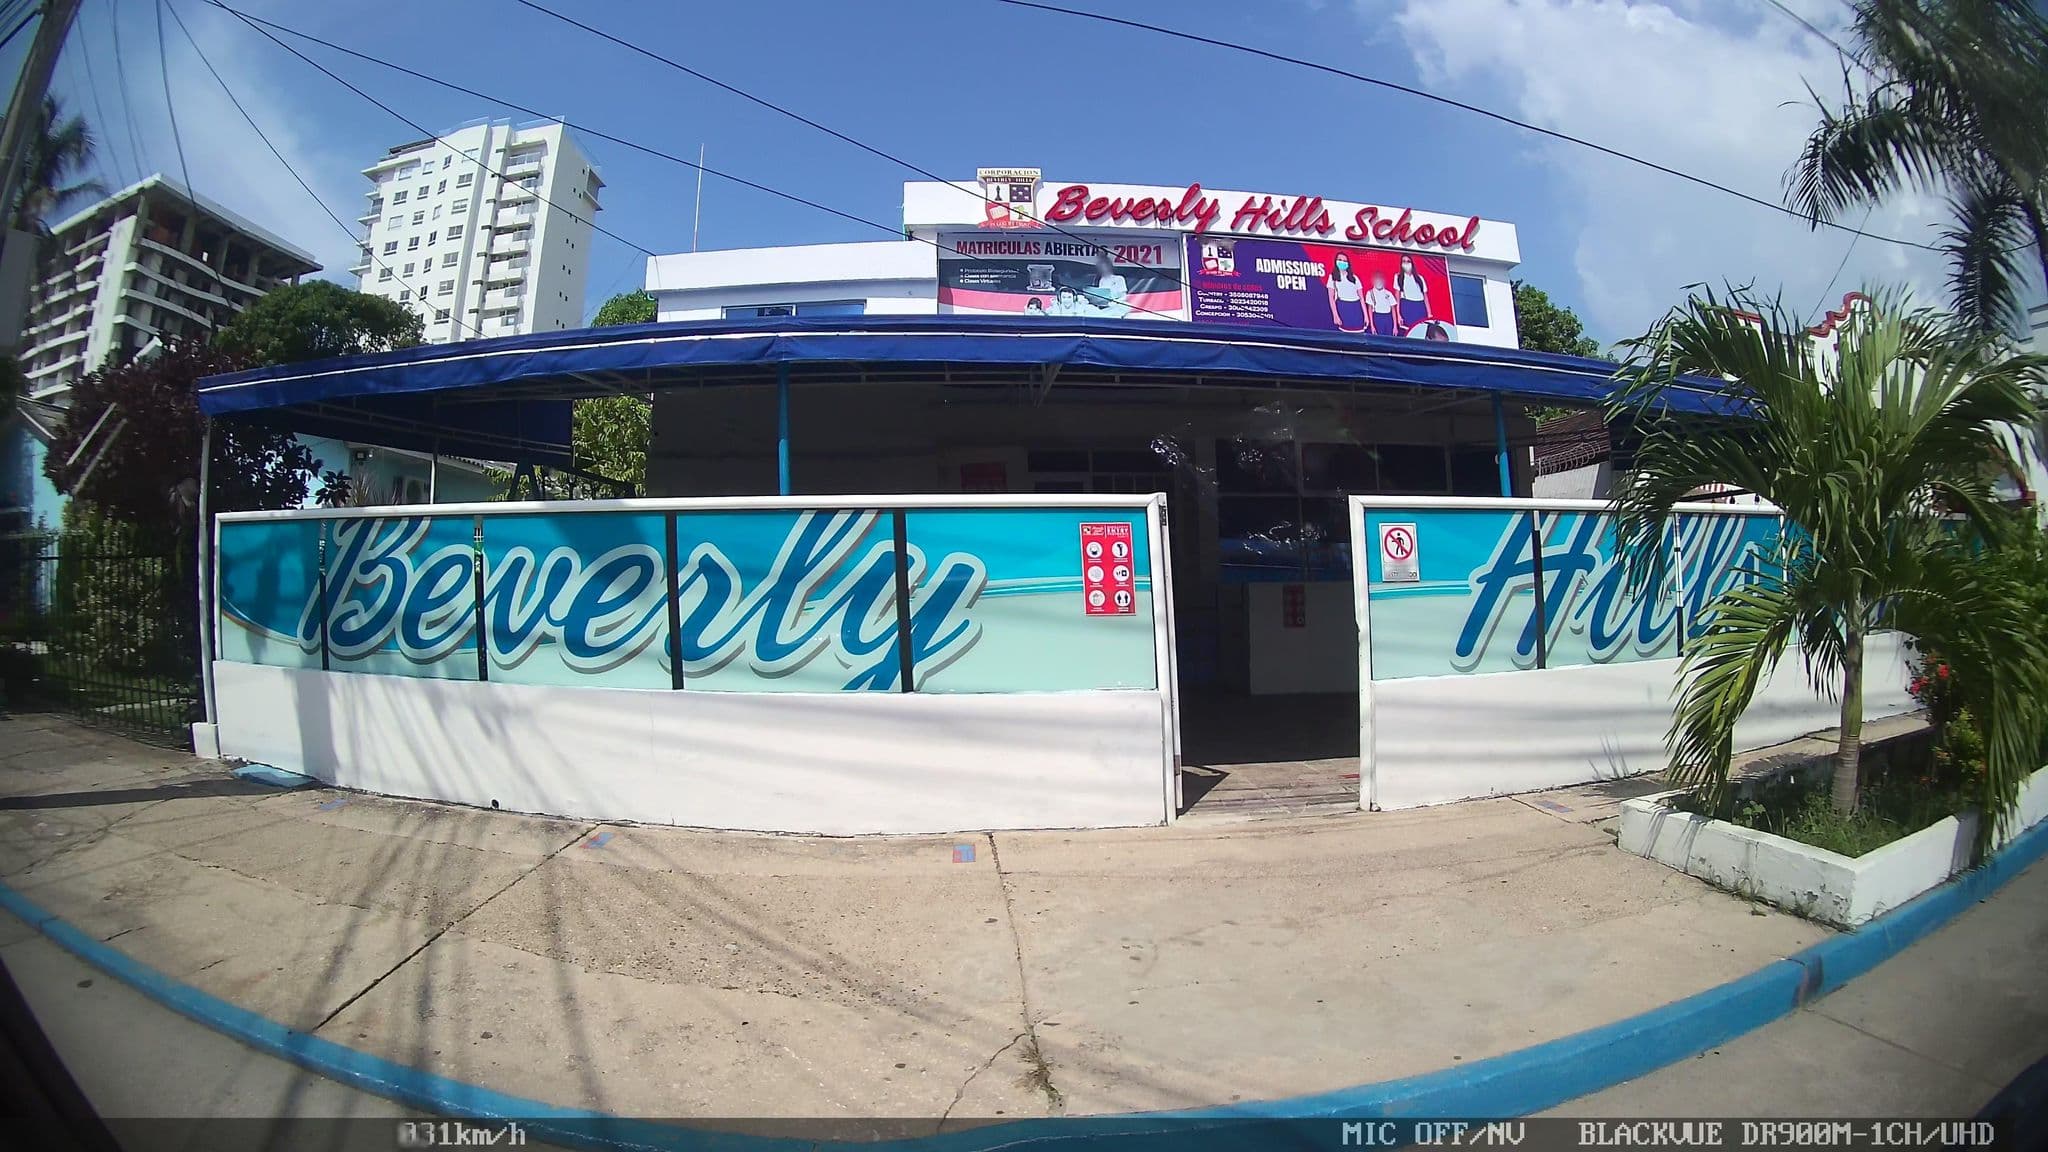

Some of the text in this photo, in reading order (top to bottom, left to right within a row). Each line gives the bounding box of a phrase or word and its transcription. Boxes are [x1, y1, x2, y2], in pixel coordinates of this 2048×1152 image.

[1044, 182, 1480, 250] Beverly Hills School
[956, 240, 1041, 256] MATRICULAS
[1113, 244, 1162, 264] 2021
[1255, 258, 1326, 277] ADMISSIONS
[1276, 274, 1307, 291] OPEN
[297, 509, 988, 692] Beverly
